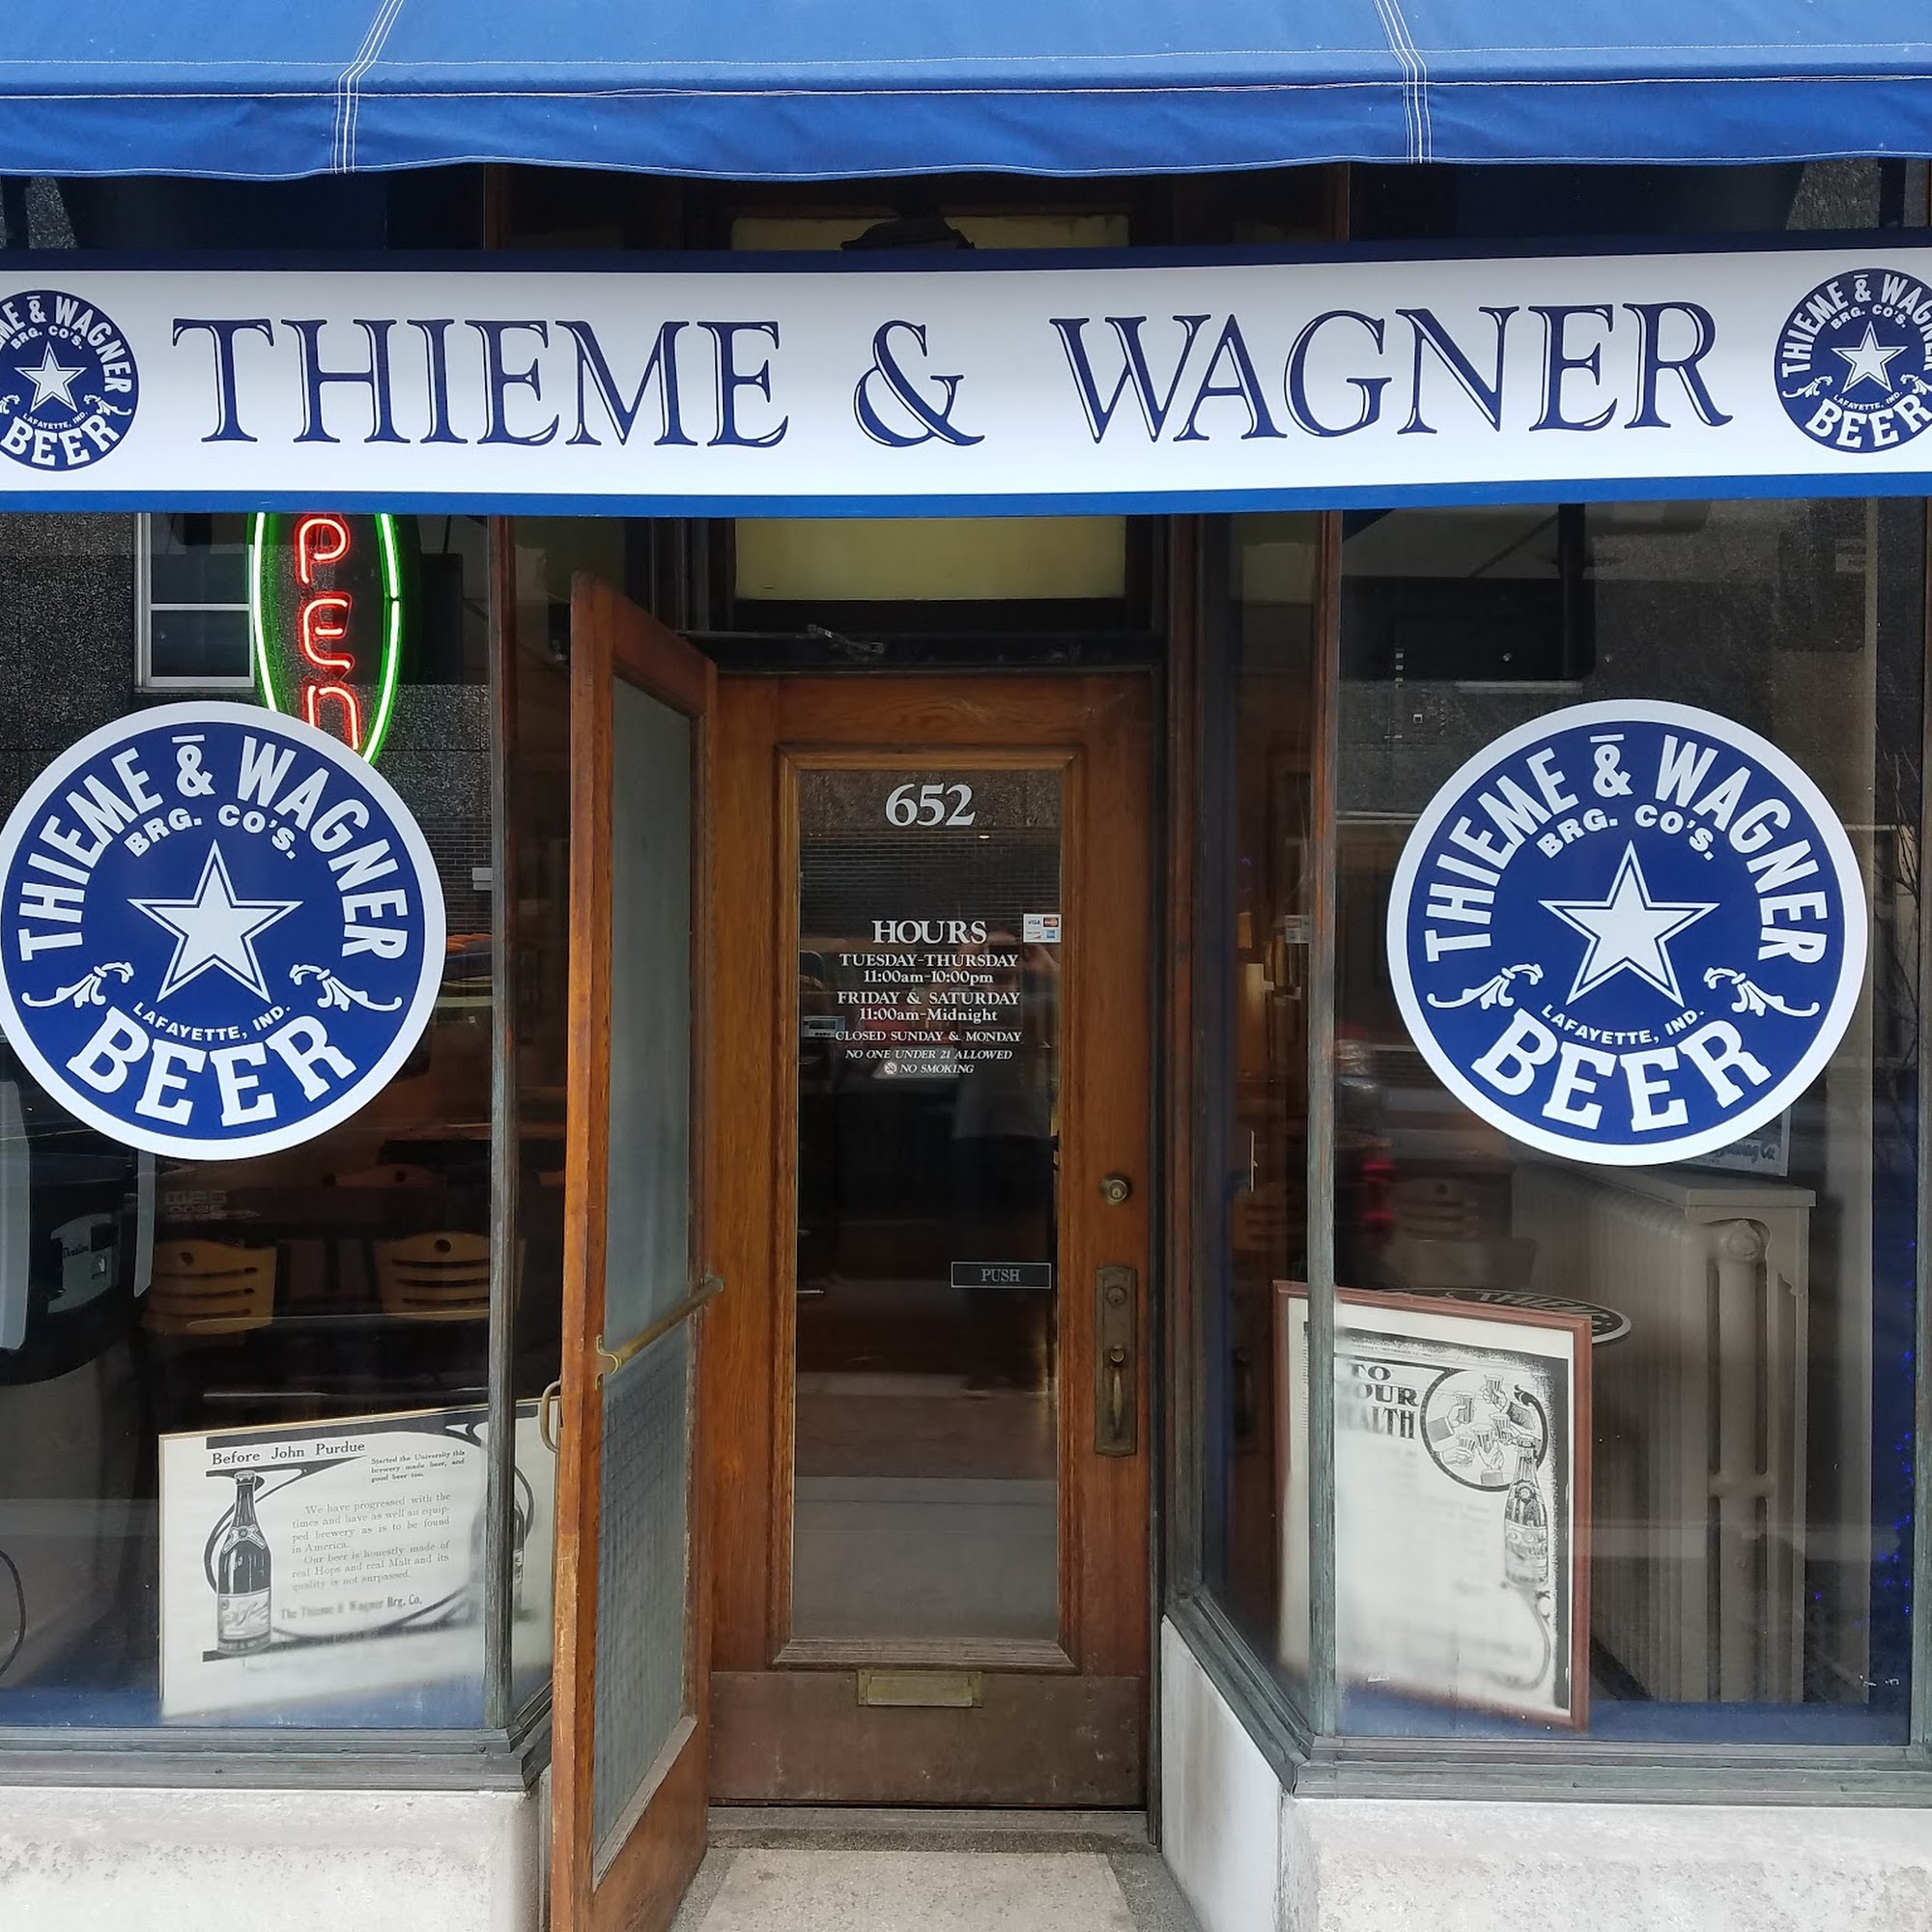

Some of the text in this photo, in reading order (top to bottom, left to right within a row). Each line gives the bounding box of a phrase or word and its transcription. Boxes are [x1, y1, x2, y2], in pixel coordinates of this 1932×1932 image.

[1781, 281, 1849, 378] THIEME
[1880, 273, 1932, 372] WAG
[1831, 303, 1906, 329] BRG. CO'S.
[10, 327, 43, 351] BRG.
[48, 325, 83, 350] CO'S.
[55, 296, 132, 393] WAGNER
[172, 301, 1733, 447] THIEME & WAGNER
[1886, 391, 1903, 405] IND.
[72, 411, 89, 425] IND.
[1804, 394, 1932, 448] BEER
[0, 413, 120, 467] BEER
[885, 782, 976, 827] 652
[124, 804, 298, 861] BRG. CO'S.
[1536, 805, 1716, 862] BRG. CO'S.
[17, 747, 164, 962] THIEME
[237, 735, 410, 960] WAGNER
[1424, 747, 1579, 962] THIEME
[1655, 734, 1829, 964] WAGNER
[871, 920, 988, 945] HOURS
[838, 953, 1019, 967] TUESDAY-THURSDAY
[864, 969, 994, 986] 11:00am-10:00pm
[838, 991, 1021, 1006] FRIDAY & SATURDAY
[132, 1001, 293, 1042] LAFAYETTE, IND.
[859, 1008, 999, 1024] 11:00am-Midnight
[1540, 1003, 1705, 1045] LAFAYETTE, IND.
[835, 1031, 1022, 1042] CLOSED SUNDAY & MONDAY
[66, 1006, 357, 1128] BEER
[845, 1049, 1013, 1060] NO ONE UNDER 21 ALLOWED
[899, 1064, 975, 1074] NO SMOKING
[1470, 1008, 1772, 1132] BEER
[981, 1268, 1020, 1282] PUSH
[1347, 1382, 1419, 1406] OUR
[212, 1440, 365, 1465] Before John Purdue
[305, 1492, 451, 1515] We have progressed with the
[292, 1518, 319, 1528] times
[322, 1516, 341, 1525] and
[345, 1514, 368, 1523] have
[385, 1509, 405, 1519] well
[292, 1532, 309, 1544] ped
[315, 1527, 355, 1539] brewery
[378, 1523, 387, 1533] is
[392, 1522, 402, 1531] to
[407, 1520, 418, 1529] be
[423, 1517, 449, 1527] found
[292, 1545, 302, 1554] in
[327, 1553, 348, 1562] beer
[410, 1543, 436, 1553] made
[440, 1540, 451, 1549] of
[292, 1568, 310, 1578] real
[314, 1566, 341, 1577] Hops
[345, 1562, 362, 1572] and
[366, 1560, 384, 1570] real
[413, 1555, 432, 1565] and
[409, 1594, 422, 1605] Co.
